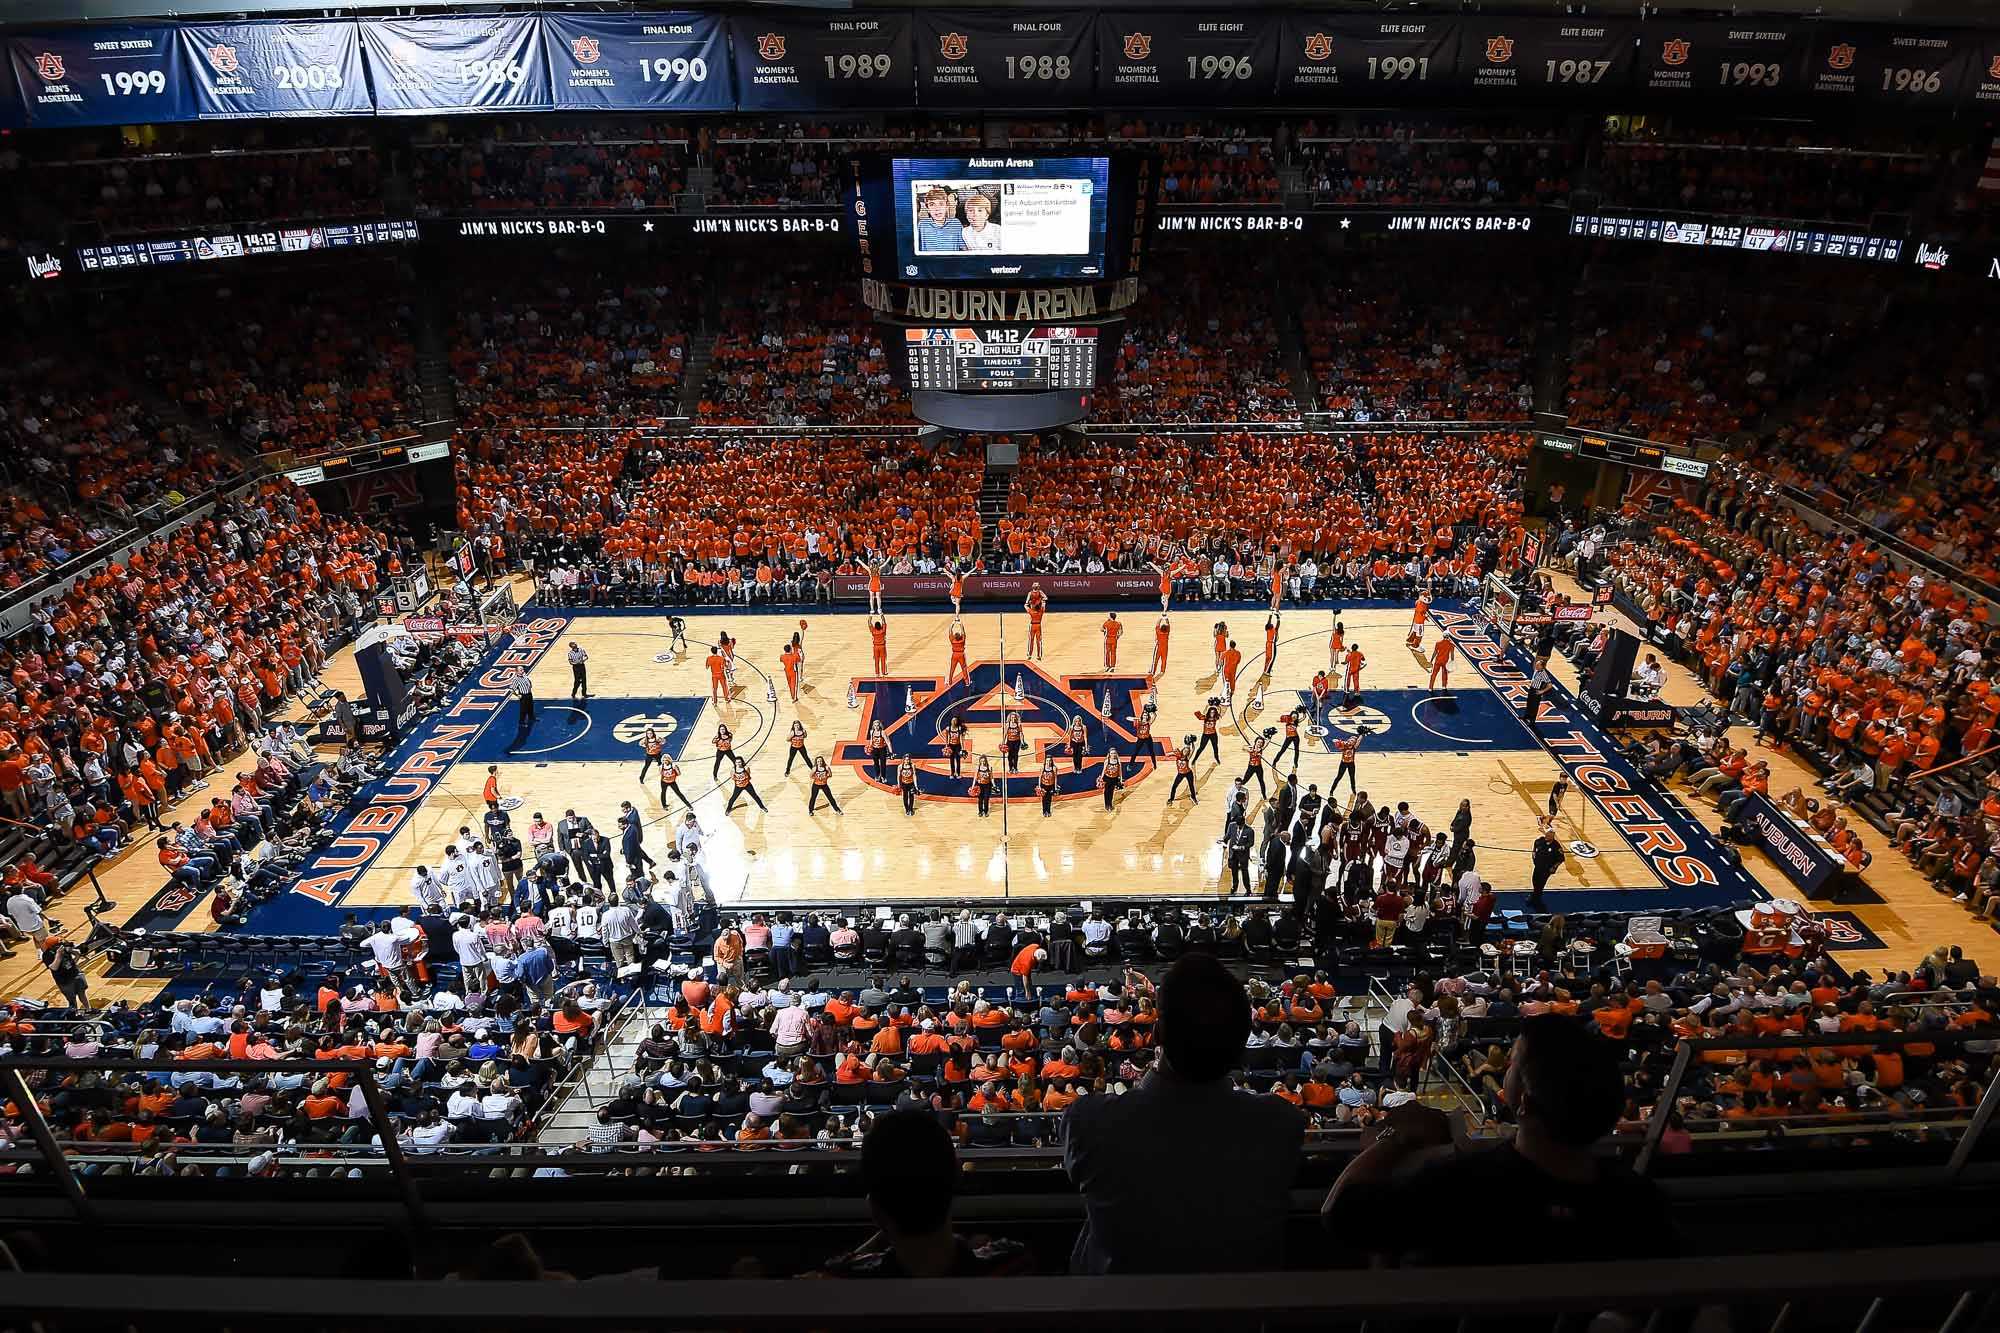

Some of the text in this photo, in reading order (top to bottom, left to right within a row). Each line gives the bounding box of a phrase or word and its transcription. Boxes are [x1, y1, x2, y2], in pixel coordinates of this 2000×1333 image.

[643, 25, 693, 35] FINAL FOUR
[830, 21, 879, 31] FINAL FOUR
[1013, 23, 1061, 32] FINAL FOUR
[1198, 23, 1243, 32] ELITE EIGHT
[1380, 24, 1426, 33] ELITE EIGHT
[1560, 28, 1605, 37] ELITE EIGHT
[1728, 32, 1786, 41] SWEET SIXTEEN
[94, 40, 152, 51] SWEET SIXTEEN
[1893, 38, 1948, 48] SWEET SIXTEEN
[640, 57, 707, 82] 1990
[755, 66, 796, 74] WOMEN'S
[824, 54, 891, 80] 1989
[936, 66, 975, 74] WOMEN'S
[1005, 56, 1071, 80] 1988
[1119, 66, 1158, 74] WOMEN'S
[1187, 56, 1253, 80] 1996
[1298, 66, 1337, 75] WOMEN'S
[1368, 57, 1429, 81] 1991
[1545, 60, 1611, 84] 1987
[274, 64, 343, 90] 2003
[570, 69, 611, 77] WOMEN'S
[1478, 68, 1516, 77] WOMEN'S
[1653, 71, 1691, 80] WOMEN'S
[1720, 63, 1781, 87] 1993
[101, 70, 166, 96] 1999
[216, 77, 242, 85] MEN'S
[568, 79, 615, 87] BASKETBALL
[753, 75, 800, 84] BASKETBALL
[933, 75, 979, 83] BASKETBALL
[1115, 75, 1160, 83] BASKETBALL
[1294, 75, 1340, 84] BASKETBALL
[1473, 77, 1518, 87] BASKETBALL
[1882, 68, 1941, 93] 1986
[45, 85, 70, 93] MEN'S
[1649, 80, 1691, 89] BASKETBALL
[207, 86, 255, 95] BASKETBALL
[37, 93, 83, 103] BASKETBALL
[968, 158, 1034, 168] Auburn Arena
[460, 220, 605, 235] JIM'N NICK'S BAR-B-Q
[692, 218, 839, 232] JIM'N NICK'S BAR-B-Q
[1158, 216, 1303, 230] JIM'N NICK'S BAR-B-Q
[1388, 217, 1531, 231] JIM'N NICK'S BAR-B-Q
[352, 226, 359, 234] 3
[1575, 223, 1657, 239] 6 8 19 9 12 6
[1711, 226, 1742, 240] 14:12
[244, 232, 277, 247] 14:12
[367, 229, 417, 242] 8 27 49 10
[1685, 231, 1700, 243] 52
[181, 240, 188, 249] 2
[288, 238, 303, 250] 47
[1749, 237, 1765, 248] 47
[220, 245, 236, 256] 52
[1796, 241, 1897, 259] 5 3 22 5 8 10
[1915, 242, 1950, 266] Newk's
[84, 252, 148, 269] 12 28 36 6
[184, 251, 191, 260] 3
[27, 253, 62, 279] Newk's
[991, 266, 1020, 274] verizon
[905, 286, 1006, 321] AUBURN
[1015, 286, 1097, 321] ARENA
[986, 329, 1019, 343] 14:12
[909, 348, 929, 356] 01 19
[960, 342, 976, 355] 52
[985, 345, 1021, 355] 2ND HALF
[1028, 342, 1044, 354] 47
[962, 358, 968, 367] 2
[1035, 358, 1041, 367] 3
[1051, 355, 1060, 363] 02
[962, 370, 969, 378] 3
[1034, 369, 1041, 378] 2
[1051, 379, 1059, 387] 12
[1543, 438, 1573, 450] verizon
[1676, 461, 1707, 474] COOK'S
[847, 583, 885, 591] NISSN
[913, 582, 950, 590] NISSAN
[983, 581, 1020, 589] NISSAN
[1053, 580, 1090, 588] NISSAN
[1116, 580, 1154, 588] NISSAN
[400, 596, 410, 606] 3
[380, 605, 393, 614] 30
[1559, 607, 1587, 618] Coca-Cola
[409, 621, 439, 630] Coca-Cola
[1579, 690, 1601, 715] Coca-Cola
[396, 701, 417, 730] Coca-Cola
[1430, 608, 1721, 888] AUBURN TIGERS
[290, 616, 567, 907] AUBURN TIGERS
[1754, 812, 1817, 877] AUBURN
[553, 916, 567, 928] 21
[580, 914, 594, 926] 10
